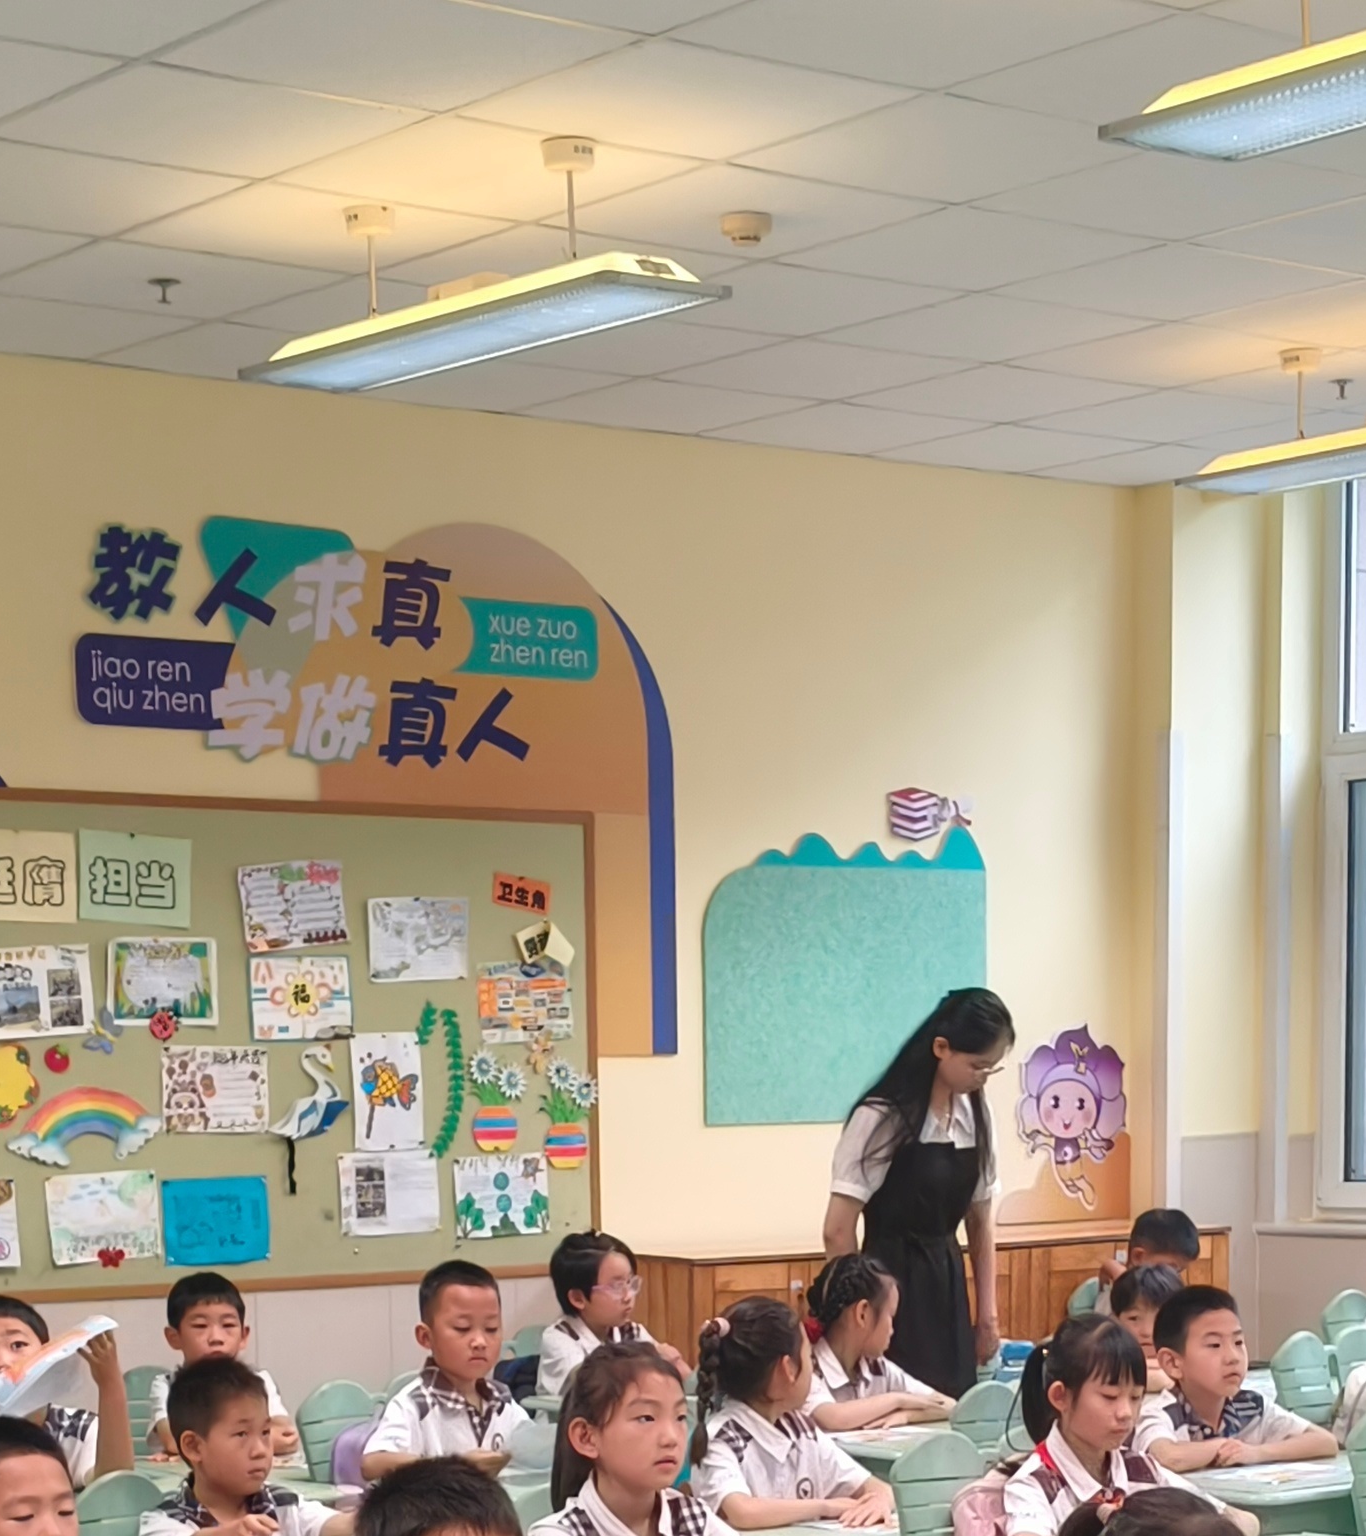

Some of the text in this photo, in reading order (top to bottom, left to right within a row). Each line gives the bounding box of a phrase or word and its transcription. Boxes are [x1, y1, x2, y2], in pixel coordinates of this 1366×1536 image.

[88, 525, 451, 651] 教人求真
[489, 614, 578, 640] xue zuo
[91, 650, 191, 683] jiao ren
[490, 642, 589, 669] zhen ren
[92, 685, 206, 716] qiu zhen
[207, 668, 531, 769] 学做真人
[89, 855, 176, 909] 担当
[497, 880, 546, 911] 卫生角
[291, 983, 311, 1006] 福
